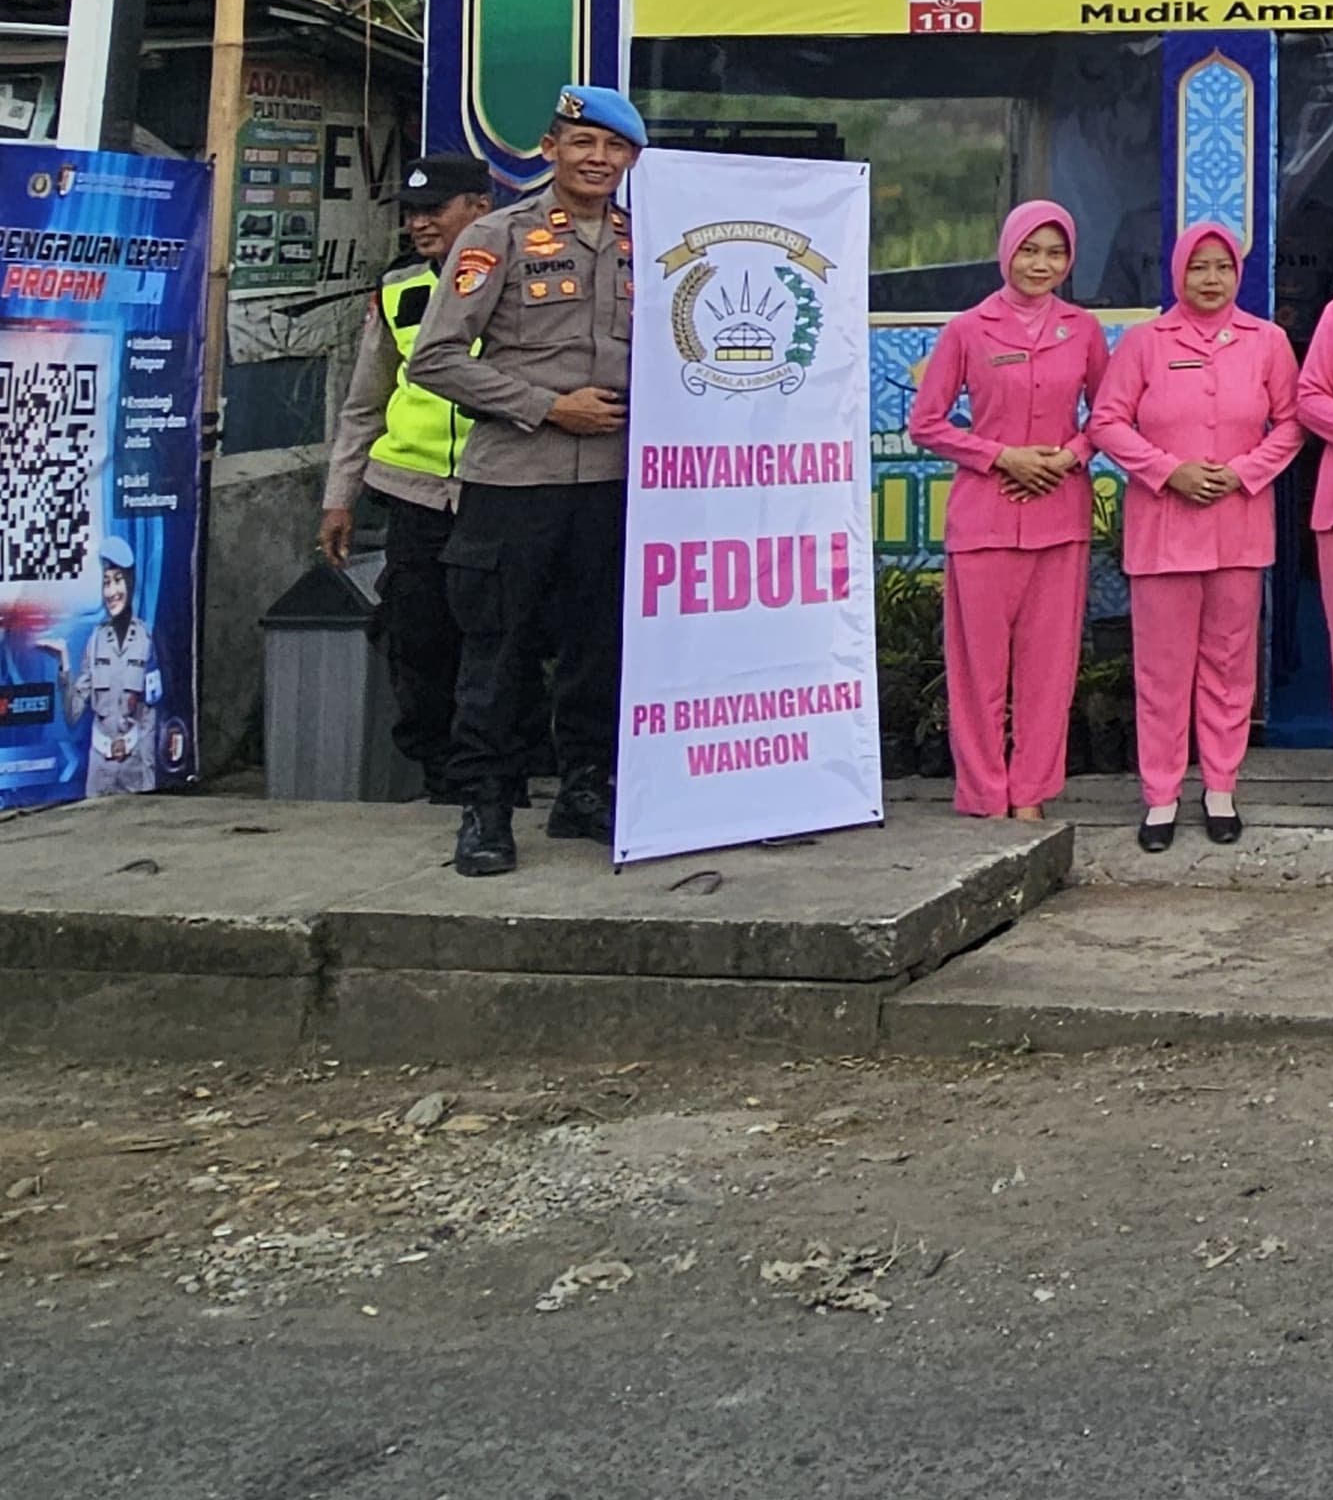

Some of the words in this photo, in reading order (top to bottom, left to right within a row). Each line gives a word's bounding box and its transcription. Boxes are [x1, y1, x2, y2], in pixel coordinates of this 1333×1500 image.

[918, 11, 975, 31] 110
[1080, 1, 1211, 26] Mudik
[247, 72, 312, 98] ADAM
[254, 102, 280, 120] PLAT
[691, 222, 803, 250] BHAYANGKARI
[525, 259, 576, 276] SUPENO
[2, 263, 108, 302] PROPAM
[695, 365, 745, 389] KEMALA
[639, 440, 854, 490] BHAYANGKARI
[641, 531, 850, 618] PEDULI
[632, 703, 667, 737] PR
[674, 679, 863, 733] BHAYANGKARI
[686, 730, 810, 777] WANGON
